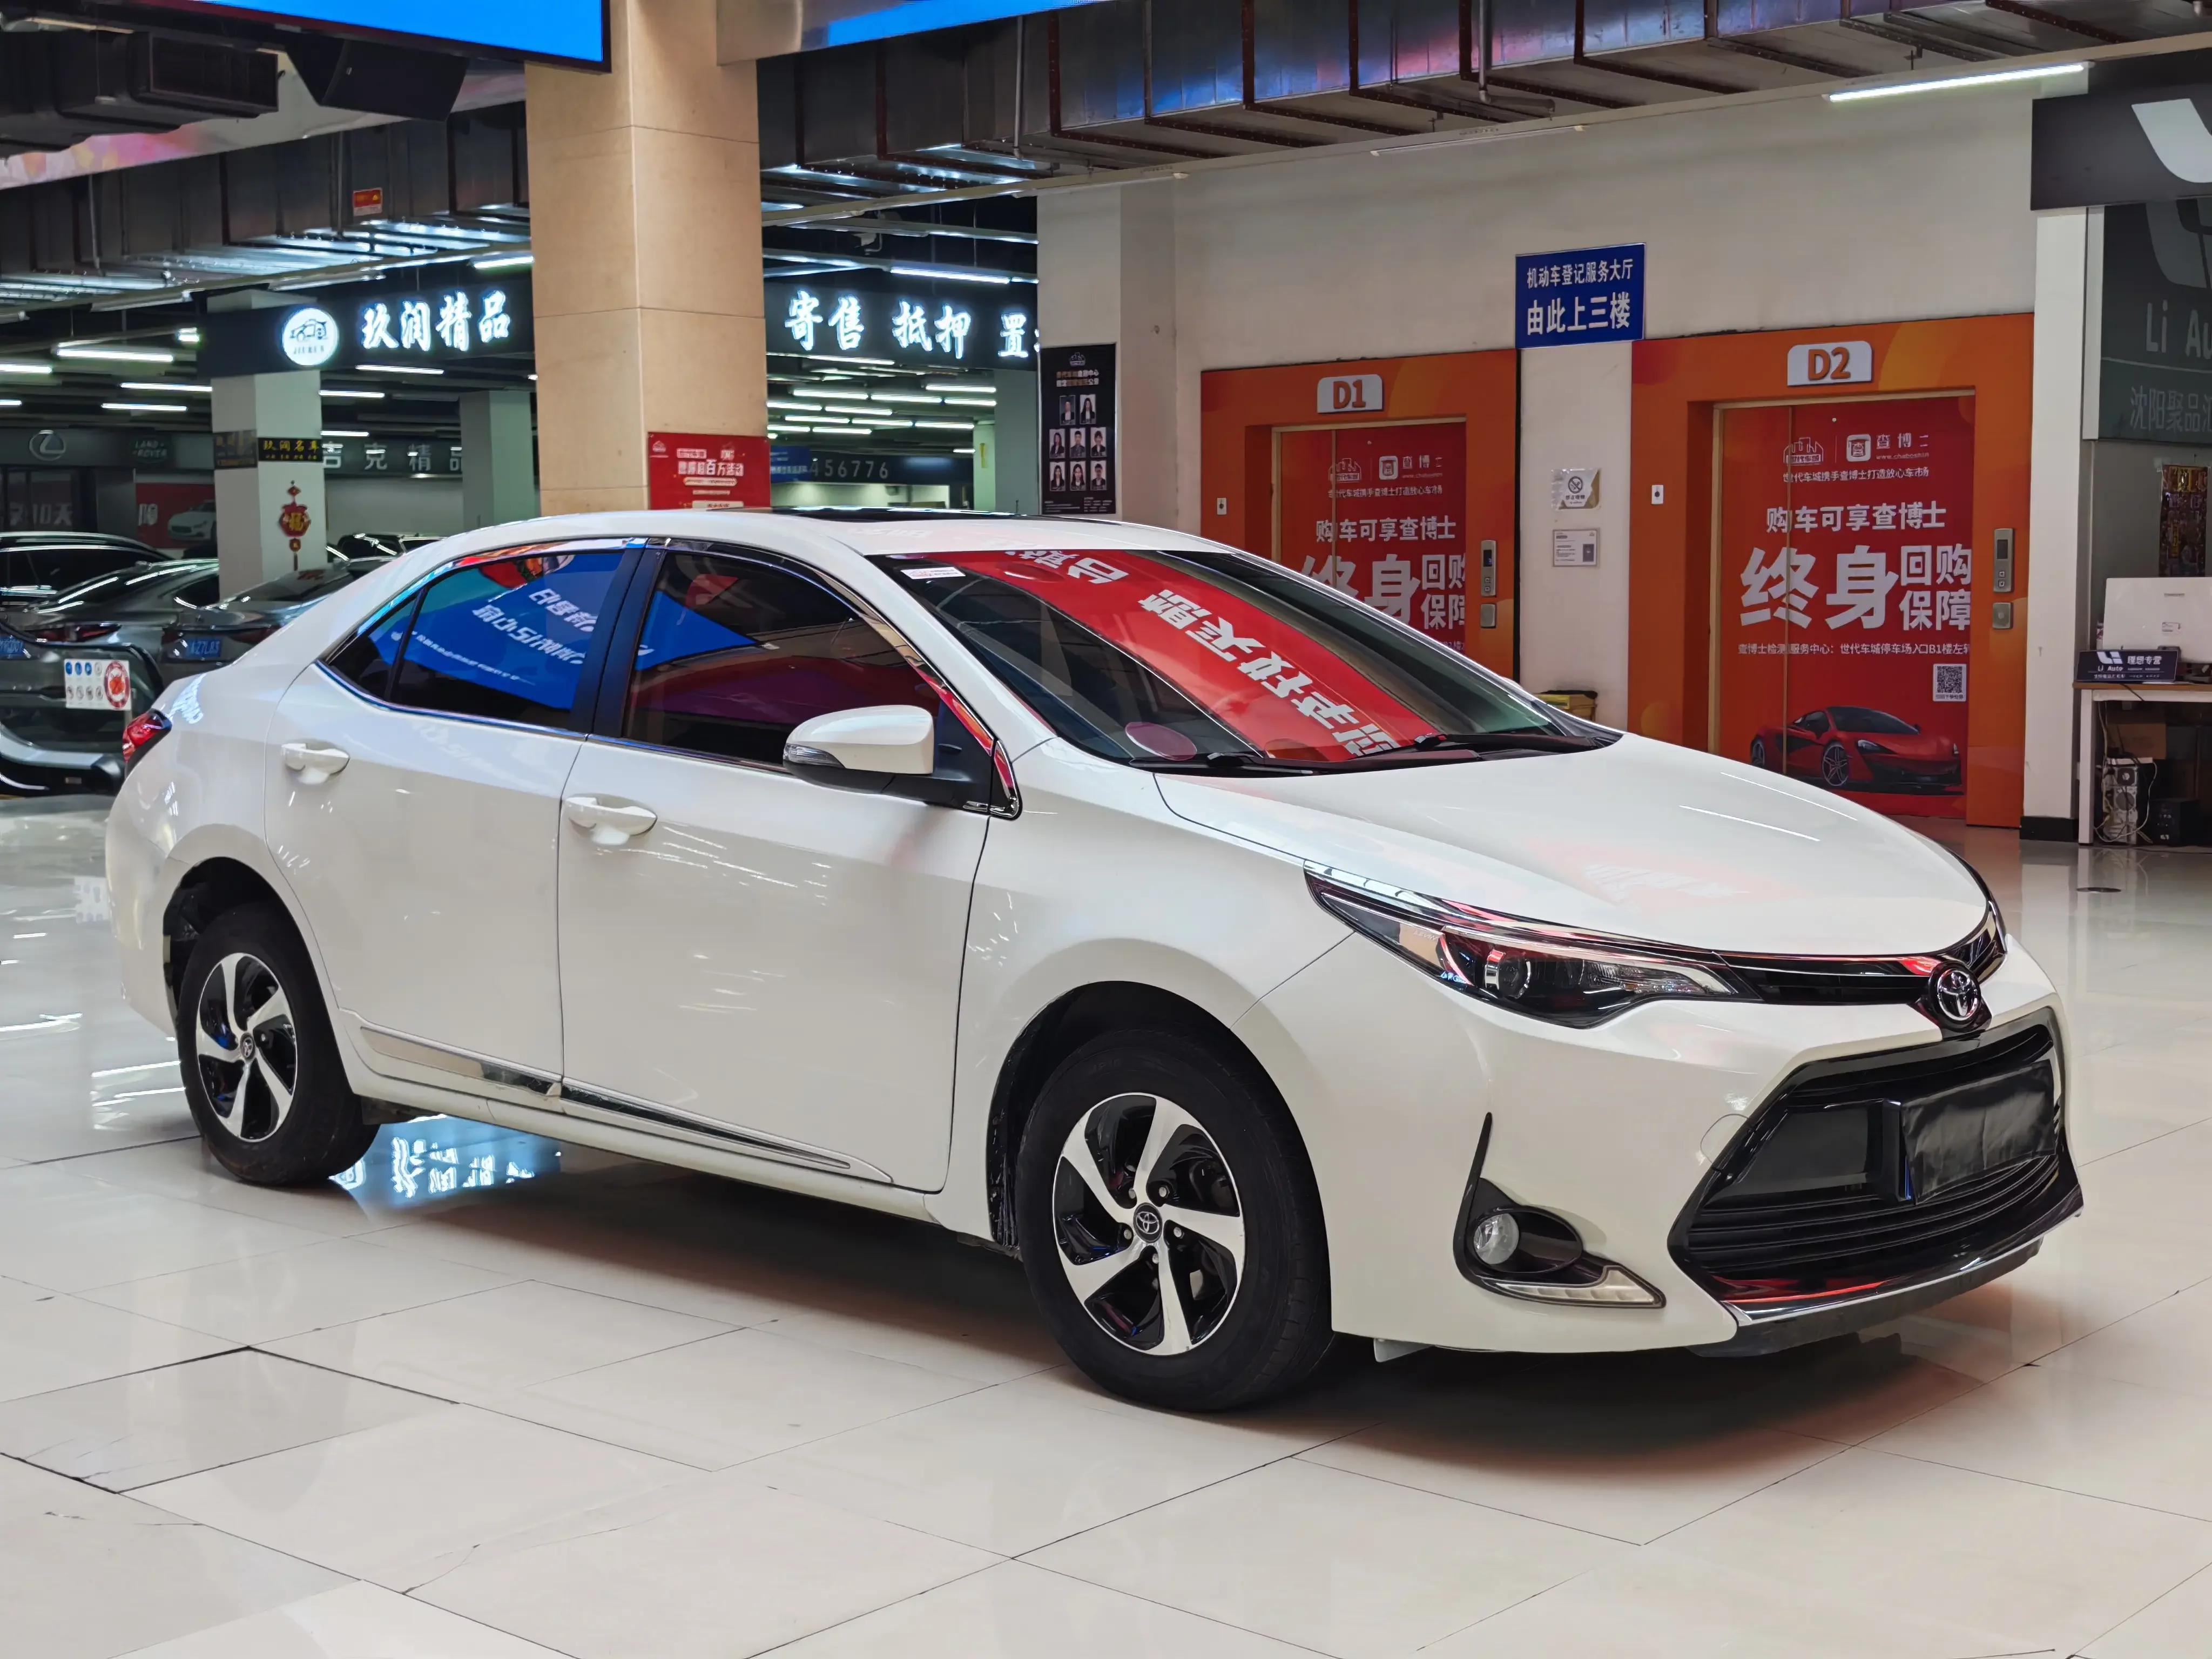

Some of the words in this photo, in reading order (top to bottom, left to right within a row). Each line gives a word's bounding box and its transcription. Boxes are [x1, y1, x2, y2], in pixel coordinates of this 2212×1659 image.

[1527, 259, 1633, 288] 机动车登记服务大厅
[785, 290, 865, 350] 寄售
[892, 300, 971, 359] 抵押
[998, 313, 1039, 358] 置
[1527, 292, 1630, 335] 由此上三楼
[2146, 300, 2168, 353] Li
[1809, 347, 1851, 380] D2
[1333, 380, 1366, 409] D1
[1317, 515, 1456, 542] 购车可享查博士
[1766, 501, 1946, 533] 购车可享查博士
[1901, 544, 1971, 586] 回购
[1740, 545, 1899, 630] 终身
[1899, 589, 1971, 631] 保障
